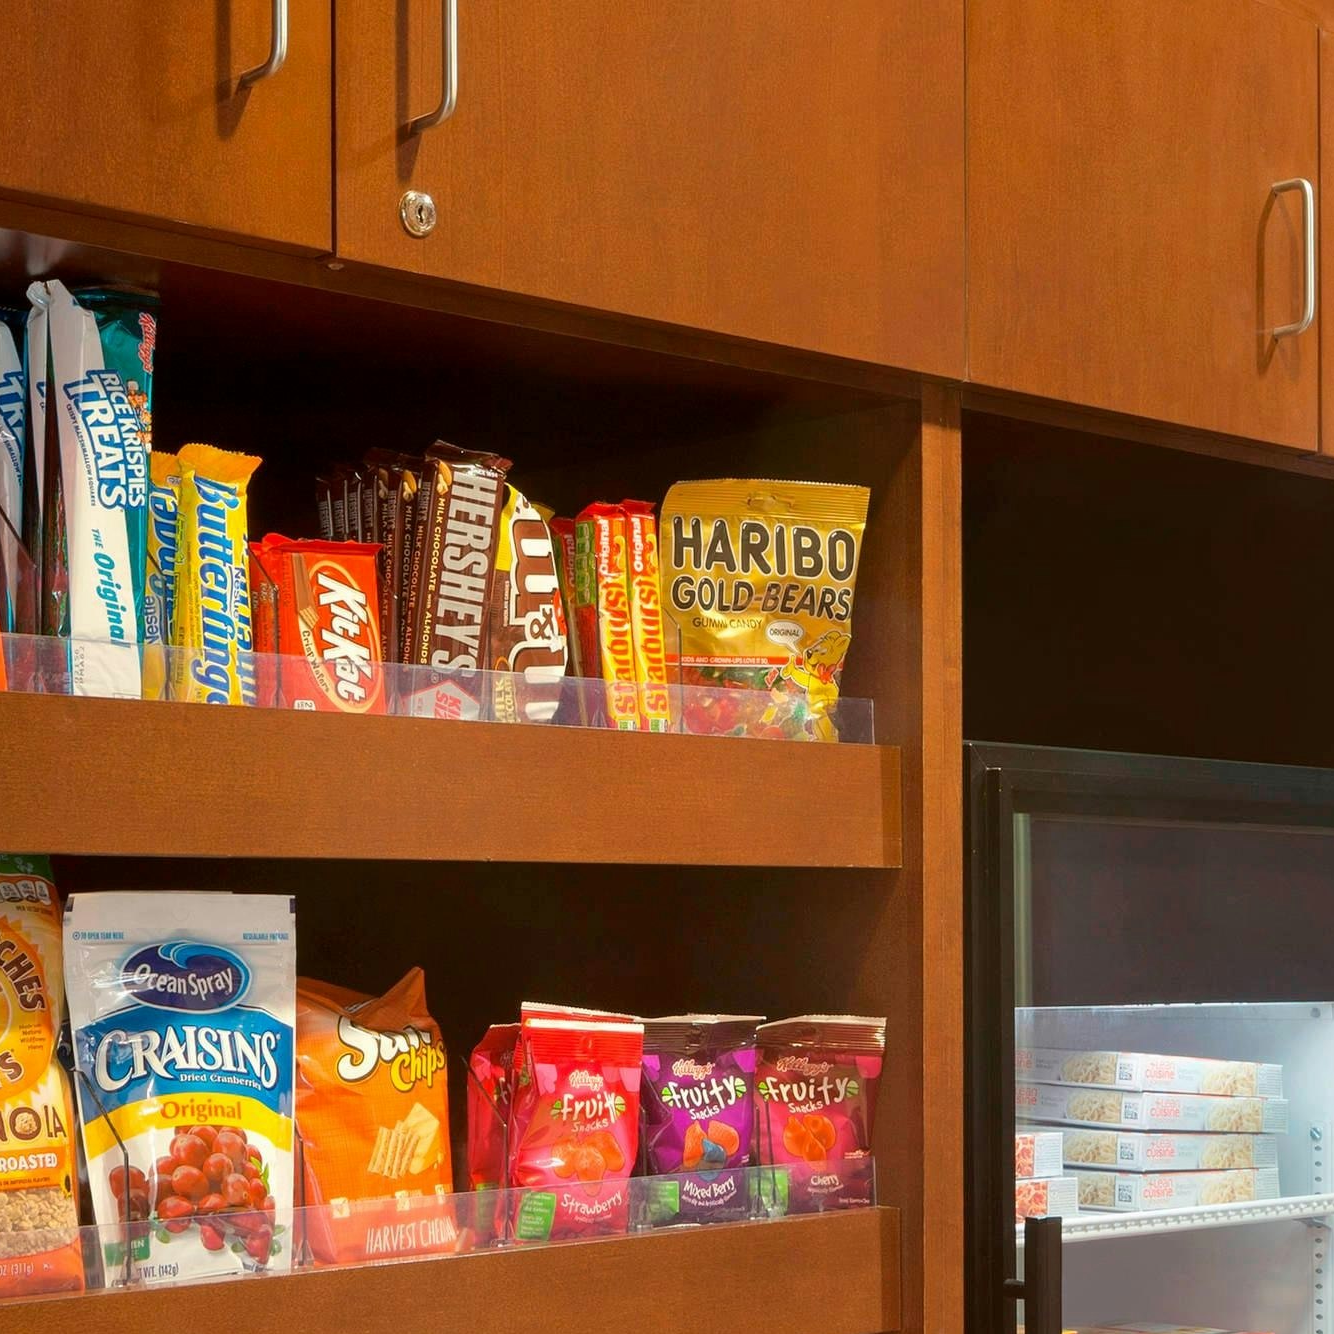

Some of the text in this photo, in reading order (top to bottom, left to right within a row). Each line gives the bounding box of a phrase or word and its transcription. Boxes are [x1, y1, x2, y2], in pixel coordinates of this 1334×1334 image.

[63, 375, 128, 509] TREATS
[100, 372, 146, 508] RICE KRISPIES
[91, 529, 104, 548] THE
[671, 515, 858, 582] HARIBO
[192, 472, 240, 704] Butterfinge
[421, 498, 445, 664] MILK CHOCOLATE ALMONDS
[431, 470, 497, 677] HERSHEY'S
[93, 552, 131, 649] Original
[671, 575, 852, 623] GOLD-BEARS
[692, 617, 763, 629] GUMMI CANDY
[769, 627, 801, 638] ORIGINAL
[134, 963, 232, 1000] Ocean Spray
[95, 1025, 277, 1092] CRAISINS
[336, 1015, 431, 1082] Sun
[179, 1073, 207, 1082] Dried
[390, 1040, 446, 1094] Chips
[672, 1058, 716, 1080] Kellogg's
[776, 1055, 833, 1076] Kellogg's
[667, 1075, 737, 1109] fruity
[765, 1076, 849, 1105] fruity
[160, 1098, 242, 1124] Original
[690, 1104, 720, 1121] Snacks
[788, 1100, 823, 1114] Snacks
[571, 1118, 608, 1133] Snacks
[683, 1179, 712, 1200] Mixed
[712, 1176, 735, 1198] Berry
[810, 1174, 839, 1187] Cherry
[561, 1190, 622, 1215] Strawberry
[366, 1222, 416, 1254] HARVEST
